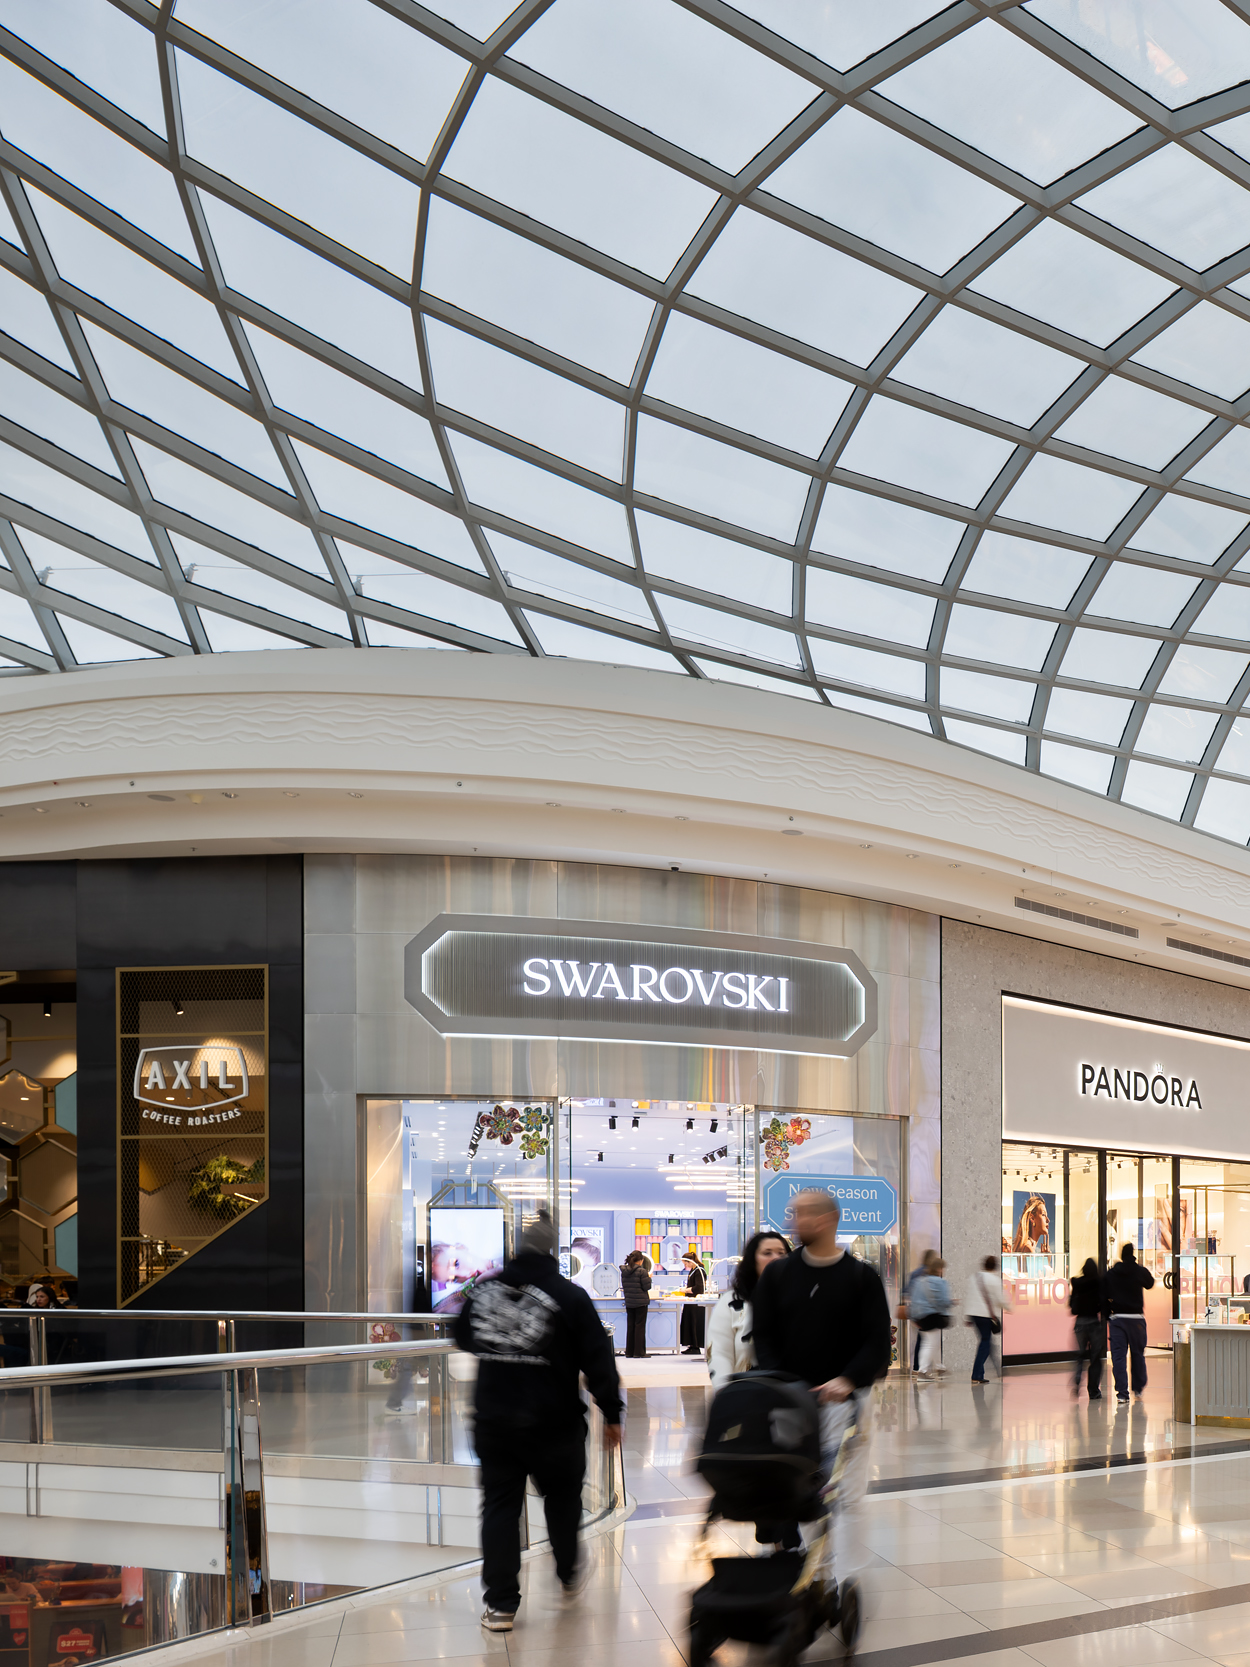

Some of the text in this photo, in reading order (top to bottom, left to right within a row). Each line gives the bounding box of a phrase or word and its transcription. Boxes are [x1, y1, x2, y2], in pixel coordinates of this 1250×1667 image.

[523, 958, 790, 1012] SWAROVSKI
[146, 1060, 236, 1090] AXIL
[1081, 1063, 1203, 1110] PANDORA
[142, 1107, 242, 1126] COFFEE ROASTERS
[827, 1184, 878, 1200] Season
[842, 1208, 882, 1222] Event
[571, 1228, 602, 1237] ROVSKI
